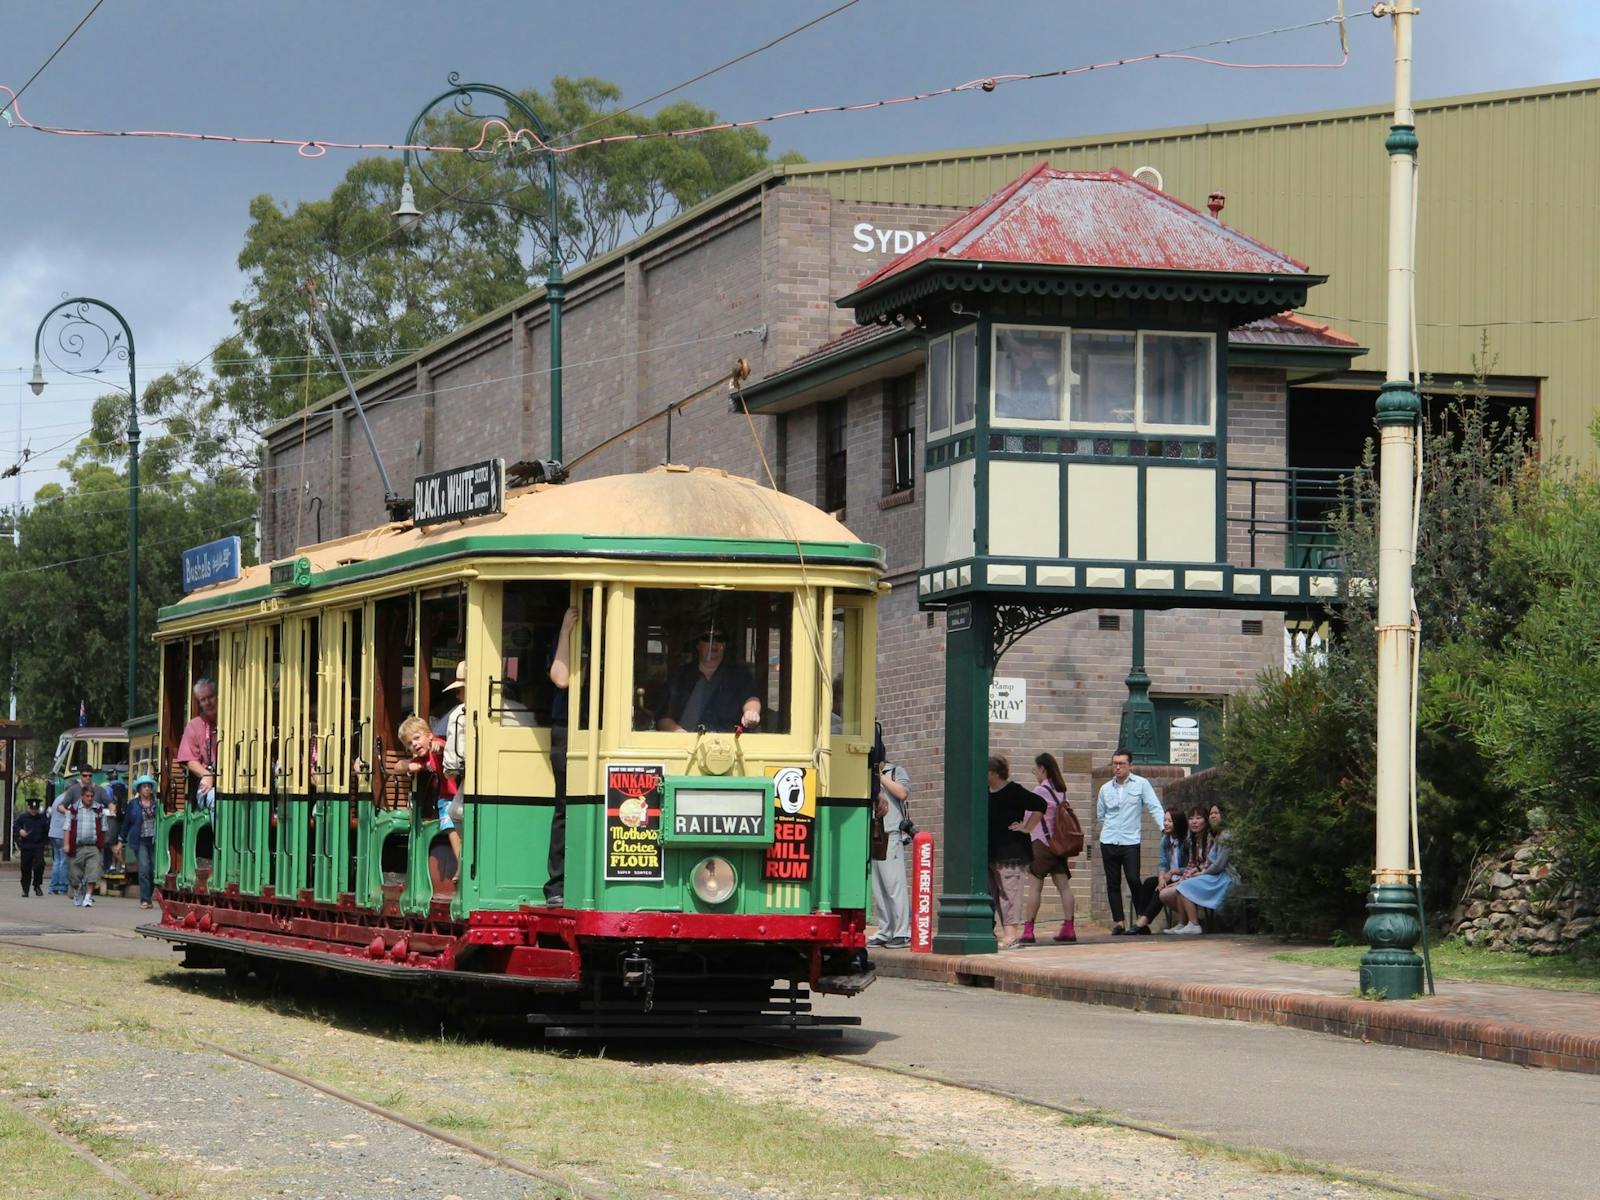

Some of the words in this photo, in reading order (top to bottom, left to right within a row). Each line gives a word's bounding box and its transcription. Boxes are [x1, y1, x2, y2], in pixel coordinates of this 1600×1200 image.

[415, 478, 440, 520] BLACK
[441, 490, 446, 516] &
[447, 470, 474, 514] WHITE
[992, 681, 1014, 692] Ramp
[676, 816, 762, 834] RAILWAY
[775, 823, 807, 841] RED
[613, 839, 658, 855] Choice
[767, 843, 810, 859] MILL
[920, 843, 931, 868] WAIT
[610, 855, 659, 867] FLOUR
[766, 861, 808, 878] RUM
[919, 869, 931, 893] HERE
[919, 895, 930, 914] FOR
[918, 916, 930, 946] TRAM
